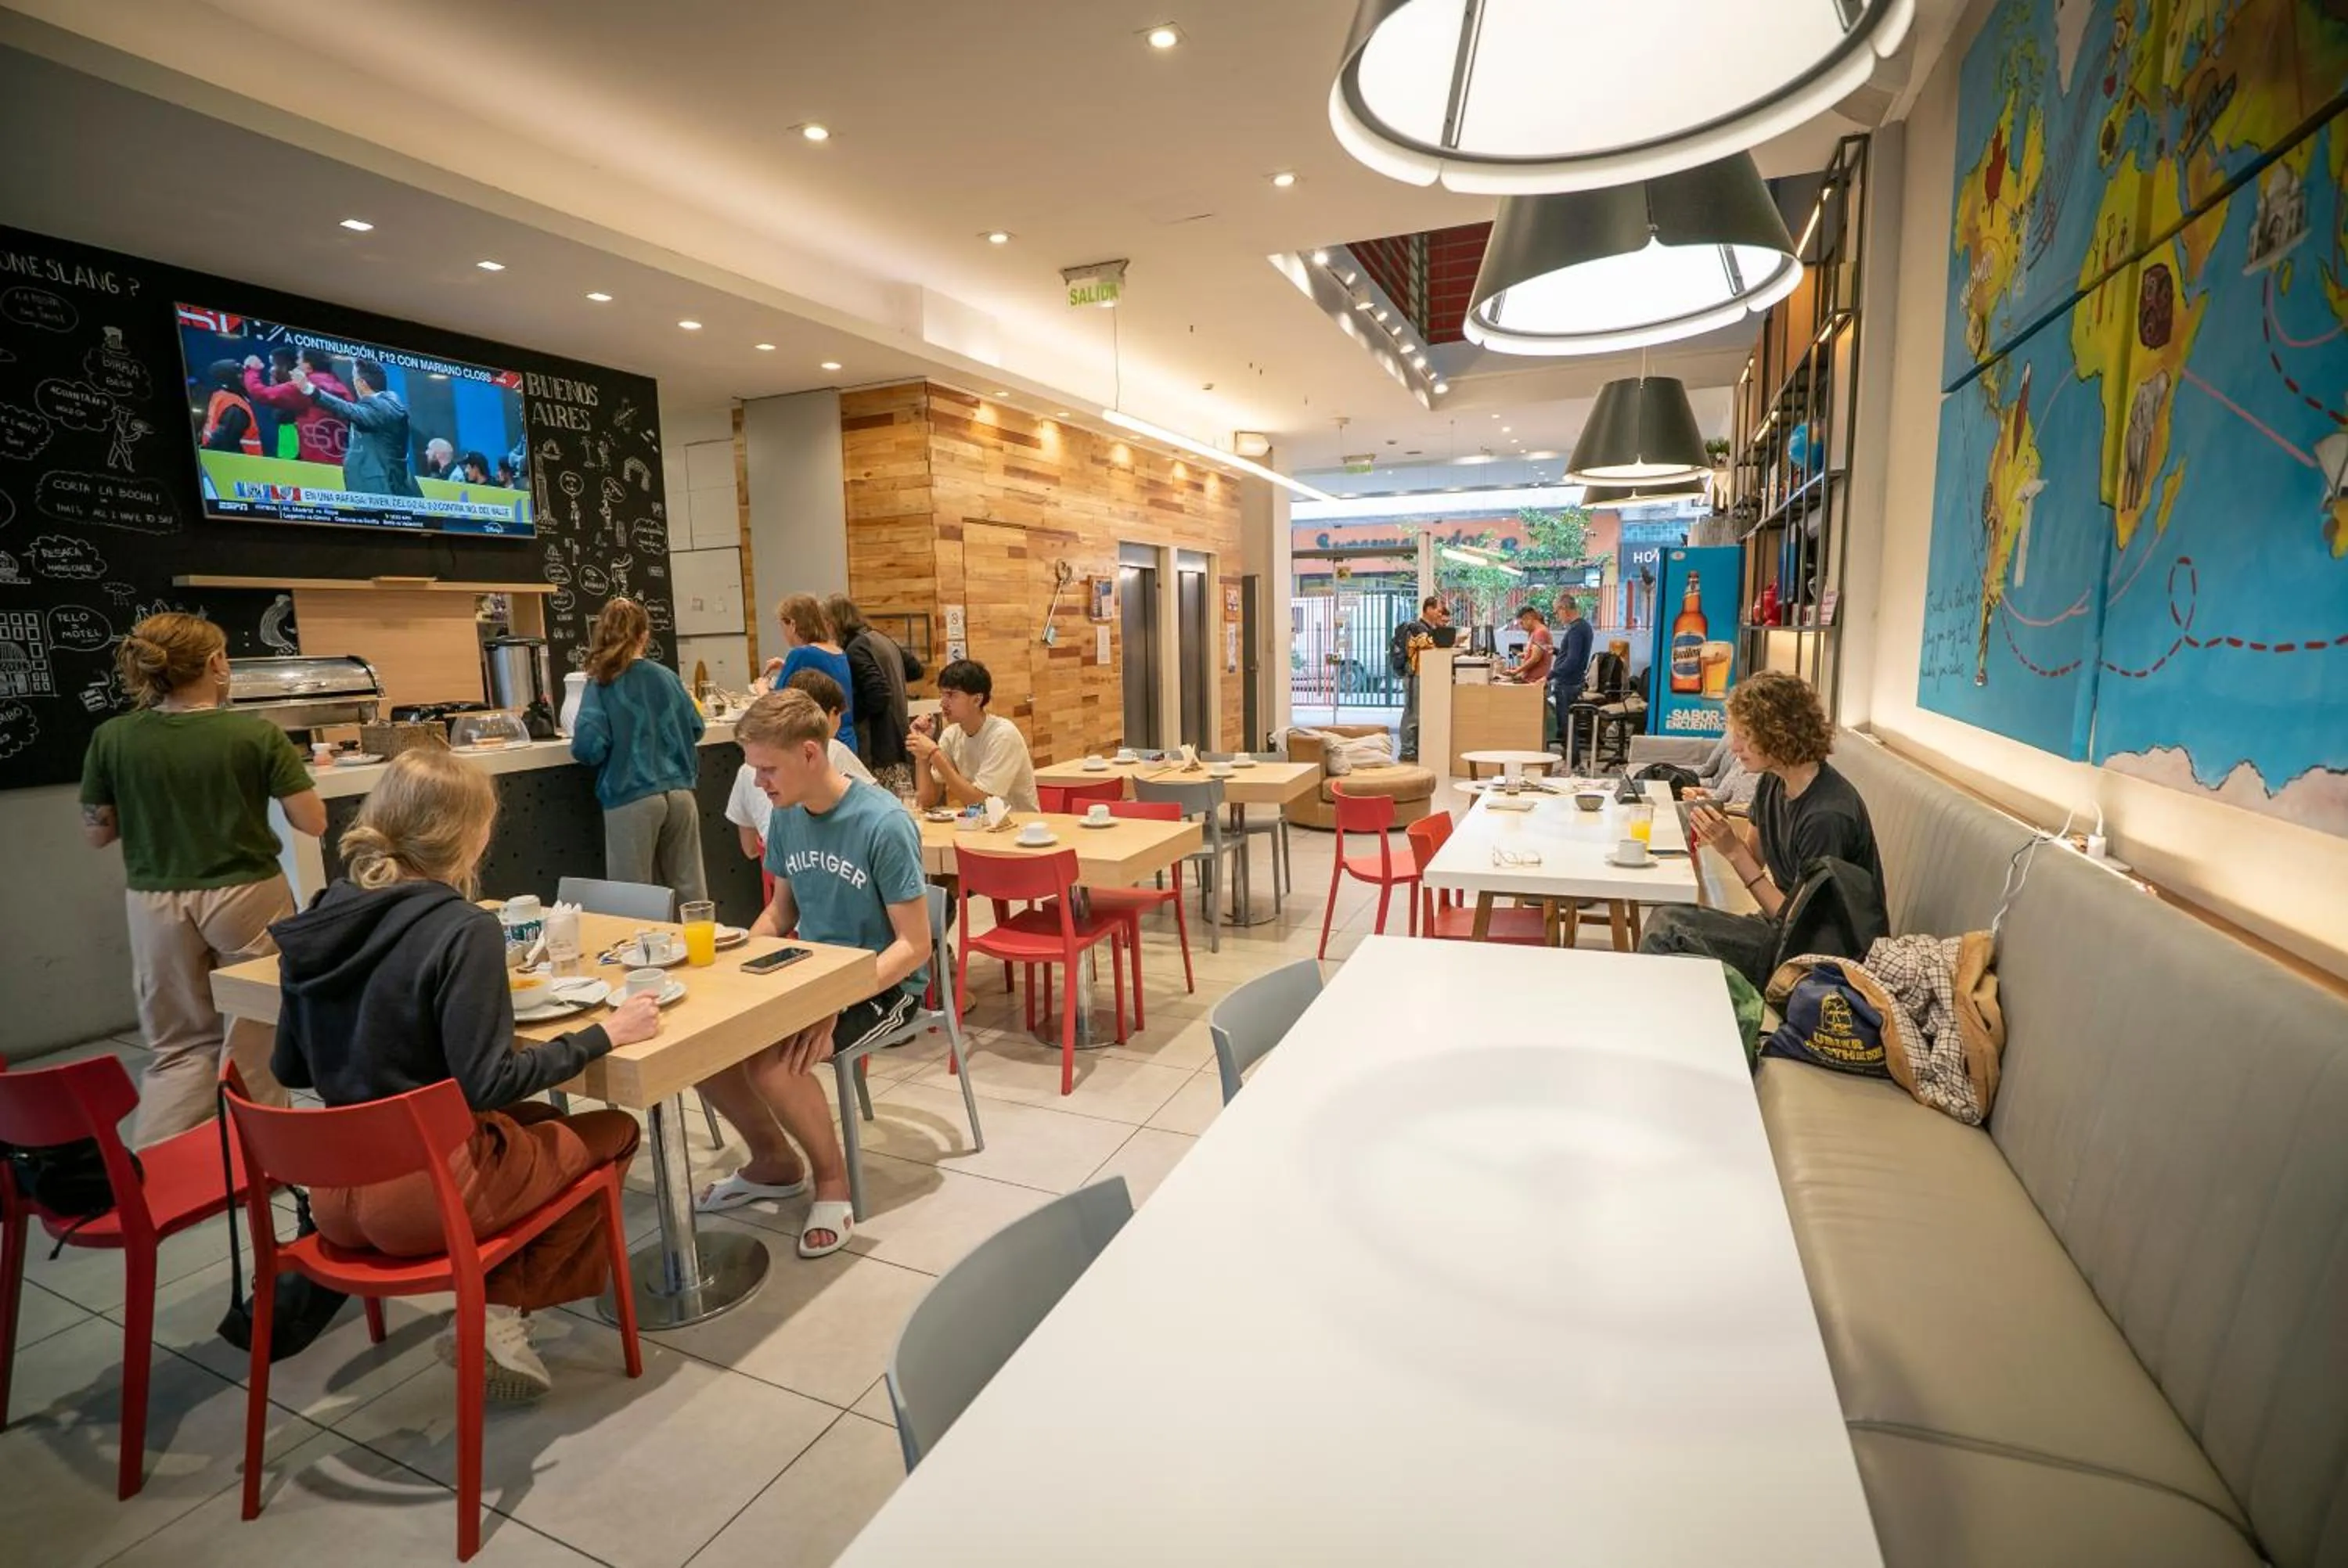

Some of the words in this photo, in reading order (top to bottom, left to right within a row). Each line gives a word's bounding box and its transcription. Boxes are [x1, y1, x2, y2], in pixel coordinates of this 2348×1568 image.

[45, 257, 120, 295] SLANG
[1070, 282, 1119, 306] SALIDA
[525, 372, 599, 407] BUENOS
[531, 401, 592, 431] AIRES
[99, 486, 113, 498] LA
[56, 612, 91, 624] TELO
[62, 629, 103, 640] MOTEL
[1671, 708, 1720, 724] SABOR
[785, 851, 866, 890] HILFIGER
